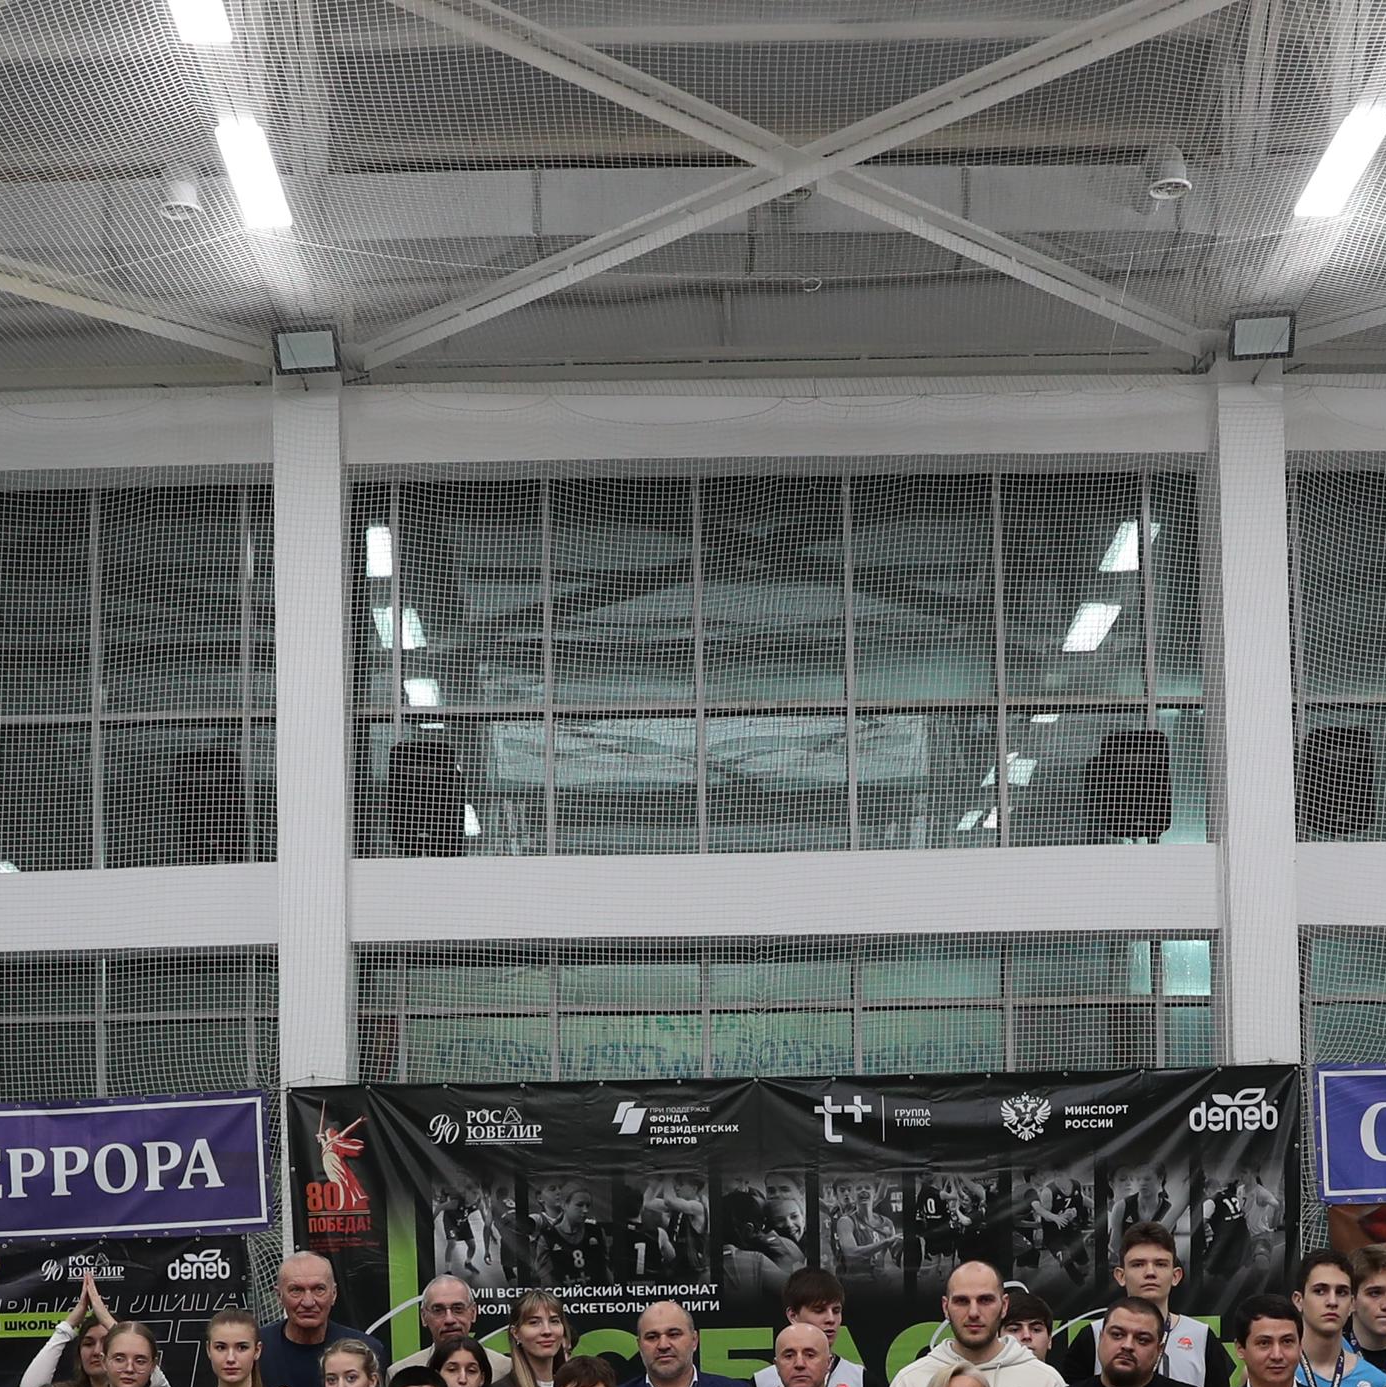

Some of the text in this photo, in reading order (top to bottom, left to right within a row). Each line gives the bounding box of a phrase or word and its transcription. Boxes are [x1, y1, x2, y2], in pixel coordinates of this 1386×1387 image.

[666, 1106, 711, 1114] ПОДДЕРЖКЕ
[894, 1108, 932, 1118] ГРУППА
[1064, 1104, 1130, 1116] МИНСПОРТ
[465, 1108, 502, 1125] РОС
[649, 1114, 689, 1124] ФОНДА
[904, 1117, 932, 1127] ПЛЮС
[1188, 1103, 1279, 1133] deneb
[649, 1124, 740, 1134] ПРЕЗИДЕНТСКИХ
[1064, 1118, 1114, 1129] РОССИИ
[465, 1124, 543, 1139] ЮВЕЛИР
[649, 1136, 698, 1145] ГРАНТОВ
[306, 1182, 342, 1211] 80
[308, 1216, 372, 1233] ПОБЕДА!
[67, 1254, 95, 1266] РОС
[67, 1266, 125, 1277] ЮВЕЛИР
[167, 1258, 231, 1281] deneb
[468, 1286, 494, 1300] VIII
[626, 1283, 719, 1297] ЧЕМПИОНАТ
